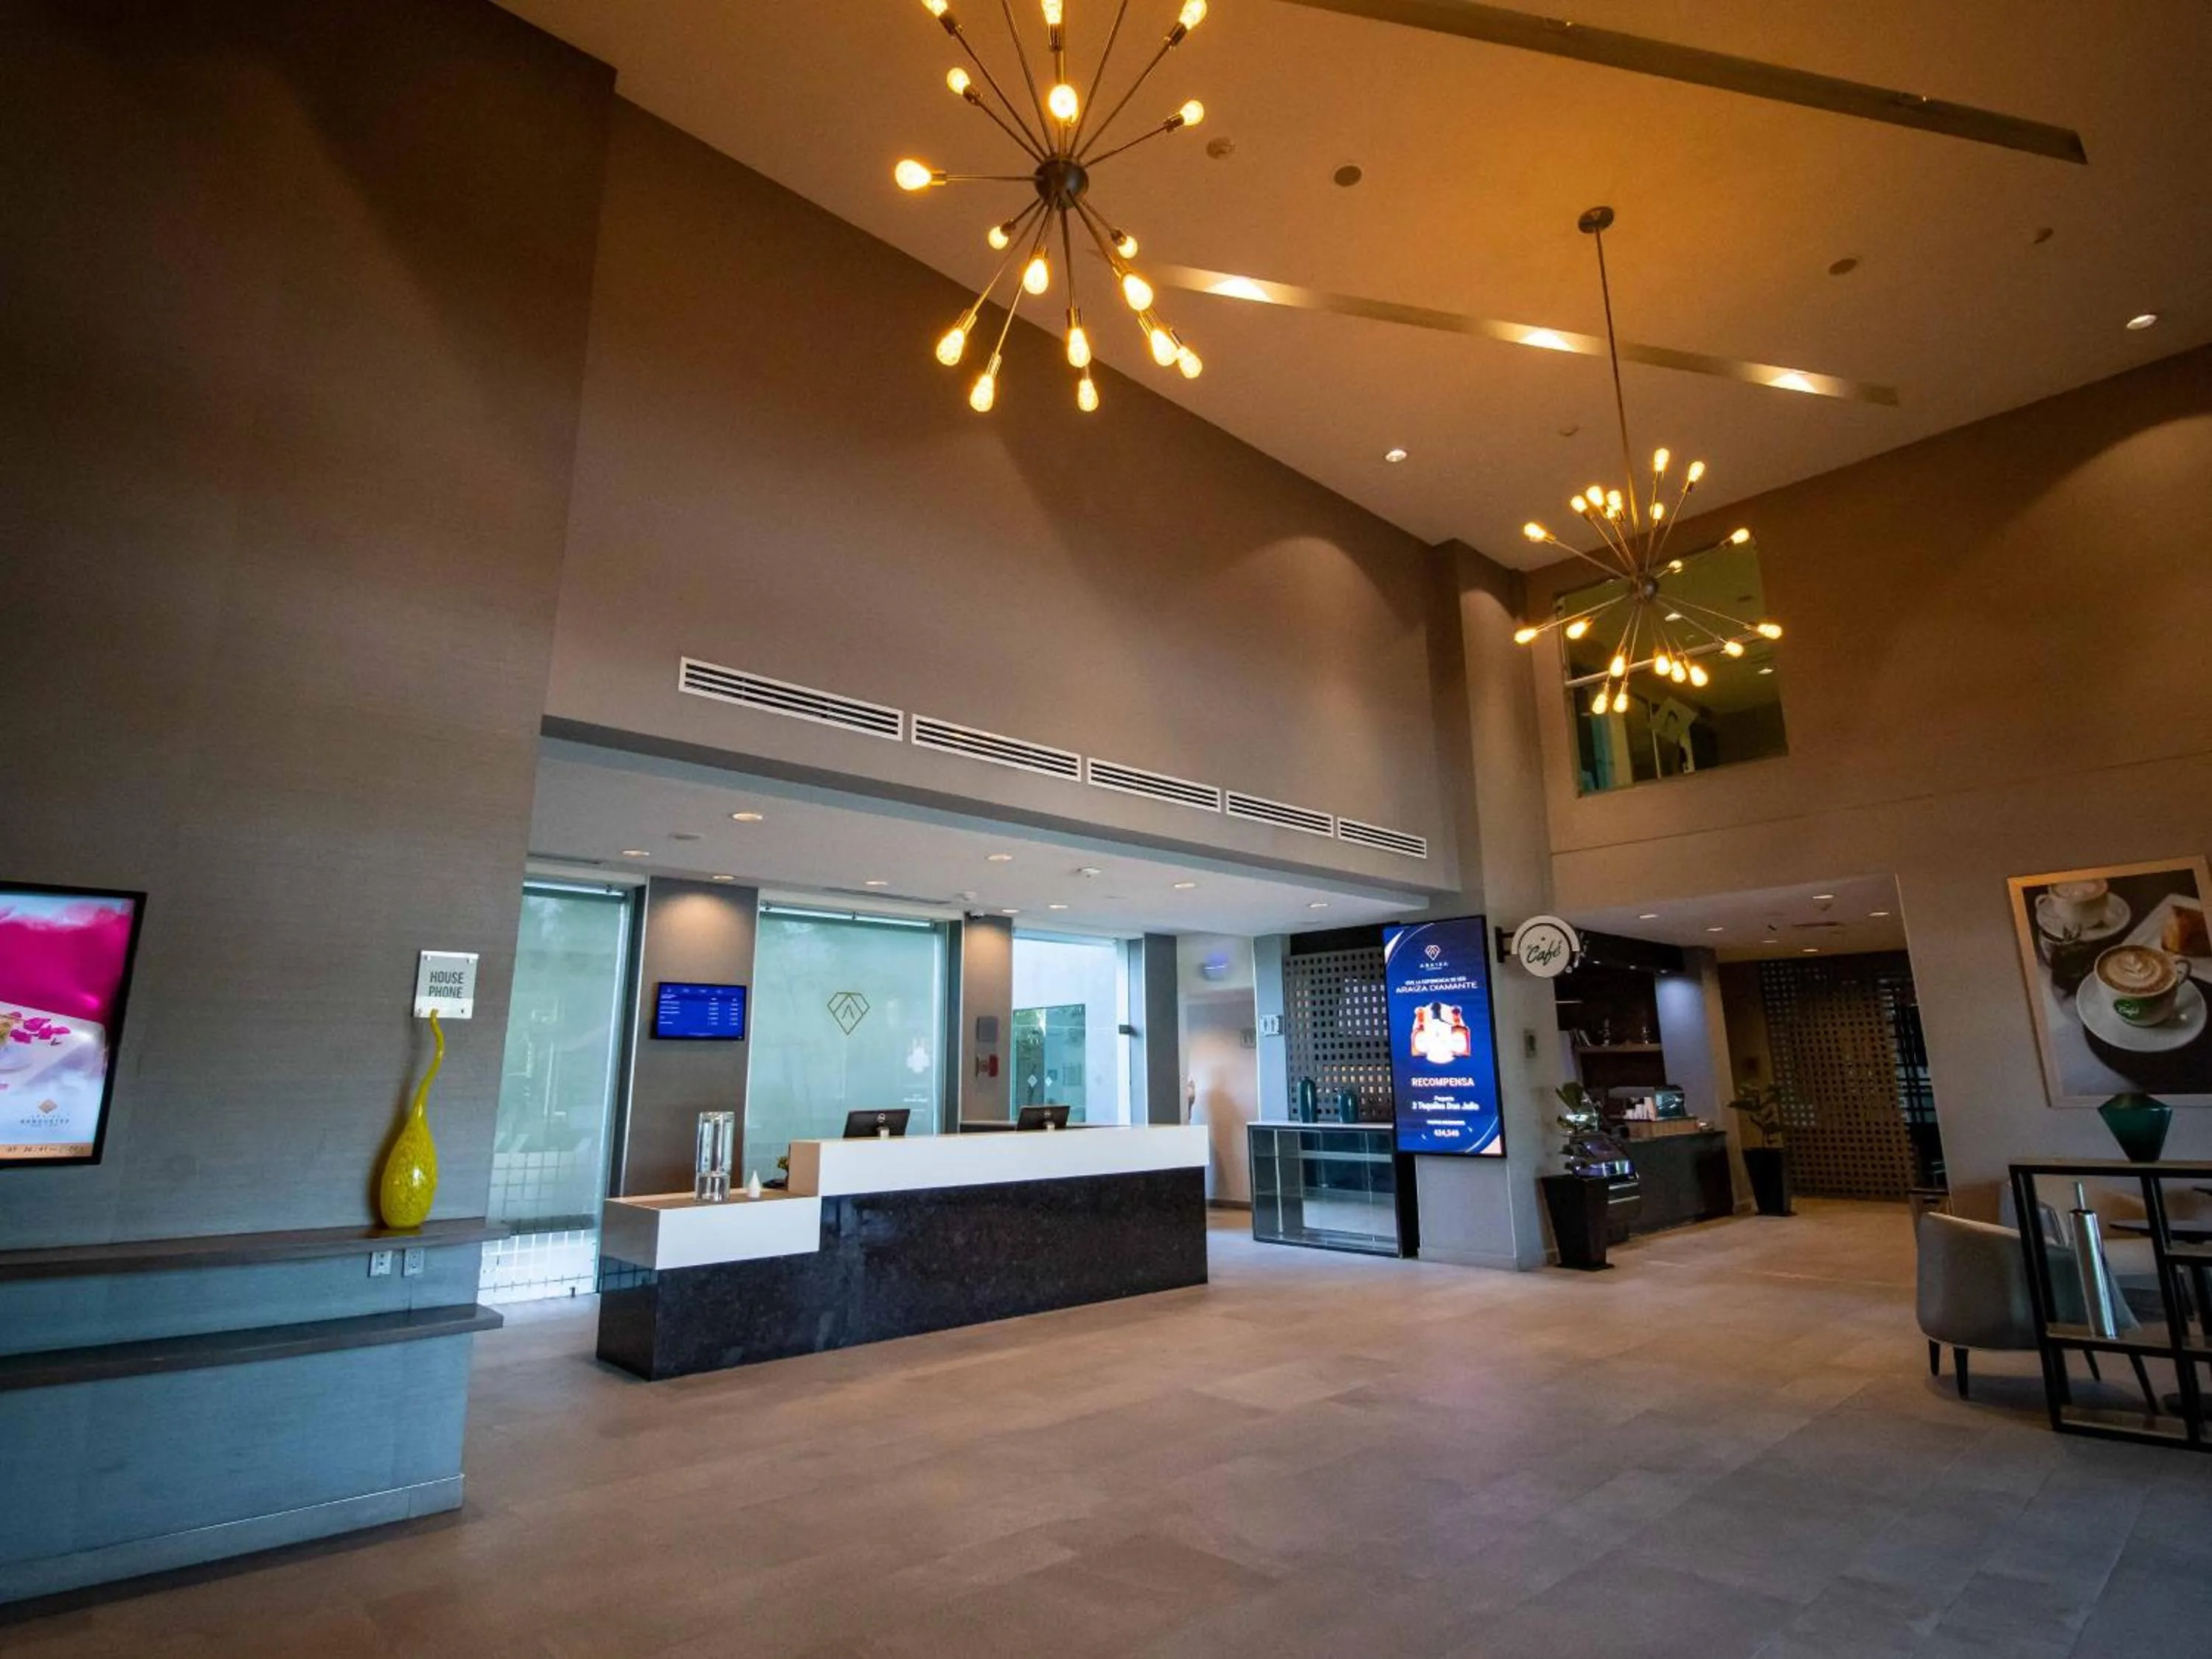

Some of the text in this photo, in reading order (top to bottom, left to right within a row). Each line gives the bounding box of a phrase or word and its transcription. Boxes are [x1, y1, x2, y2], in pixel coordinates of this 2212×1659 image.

[1527, 940, 1562, 966] Café
[430, 970, 465, 984] HOUSE
[428, 985, 462, 998] PHONE
[1396, 981, 1478, 994] ARAIZA DIAMANTE
[1411, 1077, 1475, 1087] RECOMPENSA
[1447, 1102, 1460, 1110] Don
